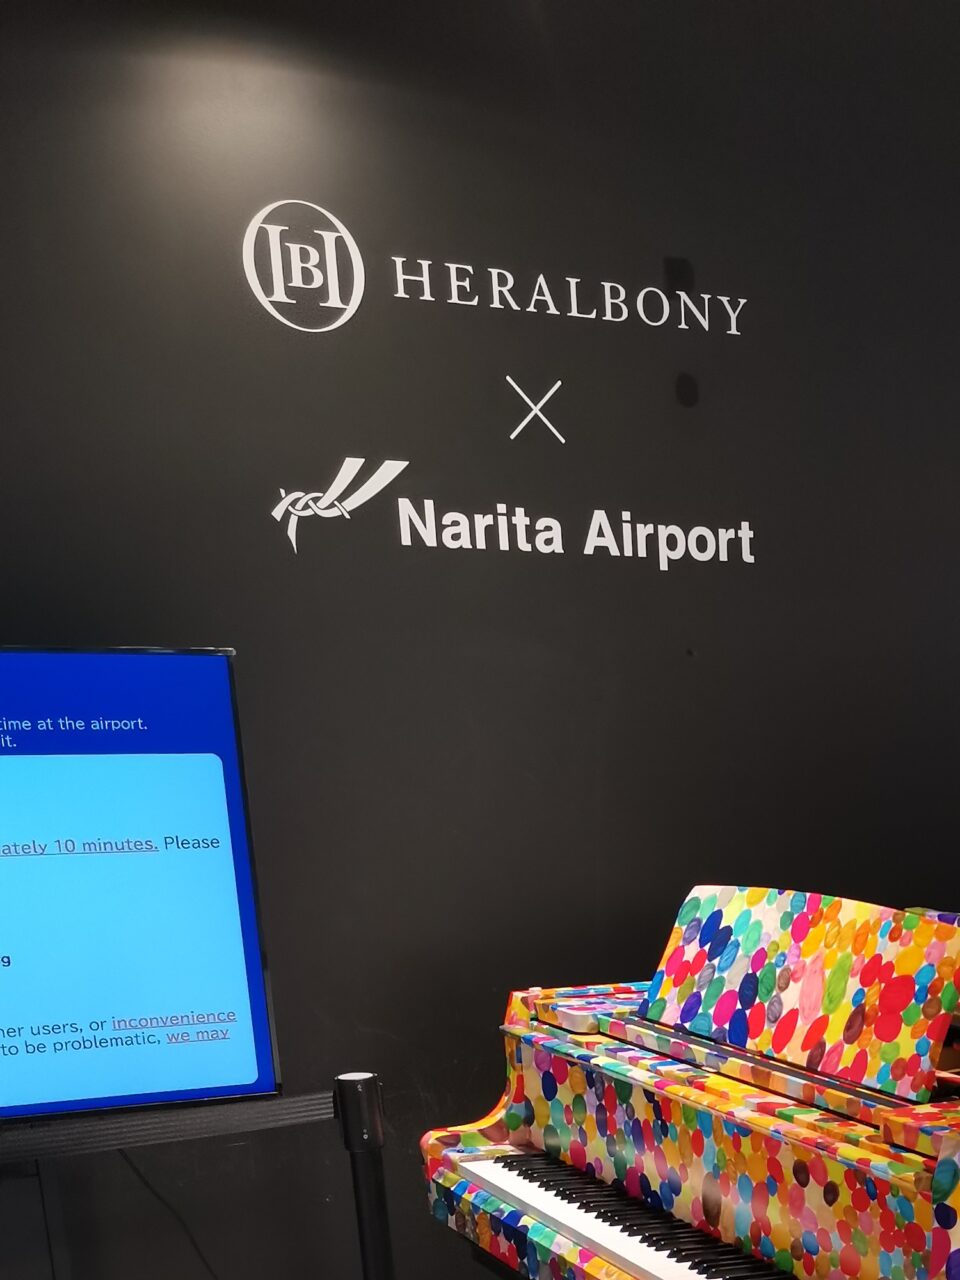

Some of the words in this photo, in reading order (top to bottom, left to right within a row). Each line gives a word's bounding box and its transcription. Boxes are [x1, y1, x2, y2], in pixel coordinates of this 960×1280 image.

[391, 256, 748, 336] HERALBONY
[398, 497, 564, 554] Narita
[583, 509, 756, 571] Airport
[37, 718, 54, 731] at
[58, 716, 86, 731] the
[90, 716, 148, 732] airport.
[0, 734, 17, 748] it.
[54, 839, 76, 853] 10
[82, 837, 159, 852] minutes.
[164, 835, 220, 850] Please
[30, 1022, 83, 1037] users,
[89, 1020, 107, 1032] or
[112, 1010, 237, 1031] inconvenience
[1, 1043, 19, 1057] to
[24, 1040, 47, 1054] be
[53, 1031, 161, 1054] problematic,
[166, 1031, 190, 1045] we
[196, 1028, 230, 1042] may
